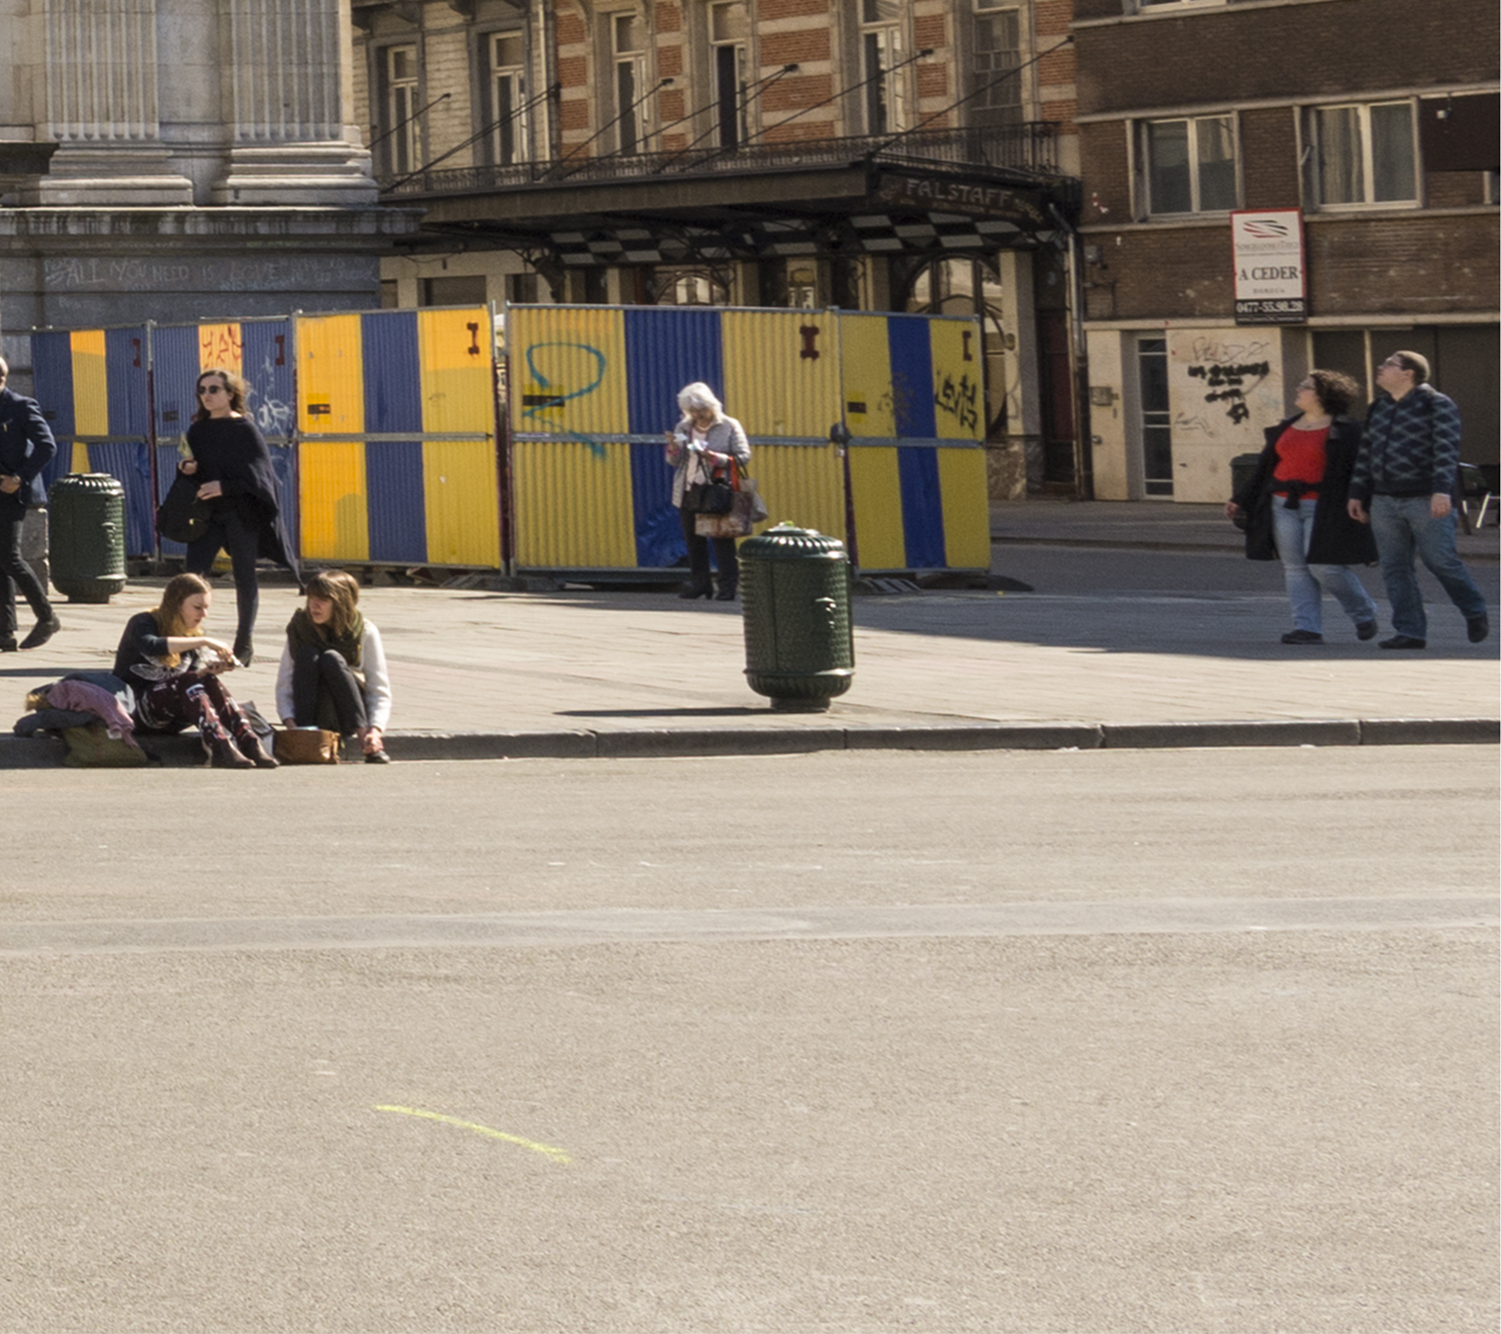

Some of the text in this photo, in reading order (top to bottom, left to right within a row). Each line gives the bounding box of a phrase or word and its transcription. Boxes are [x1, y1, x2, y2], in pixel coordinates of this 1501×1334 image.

[905, 178, 1014, 207] FALSTAFF
[1238, 266, 1299, 281] A CEDER
